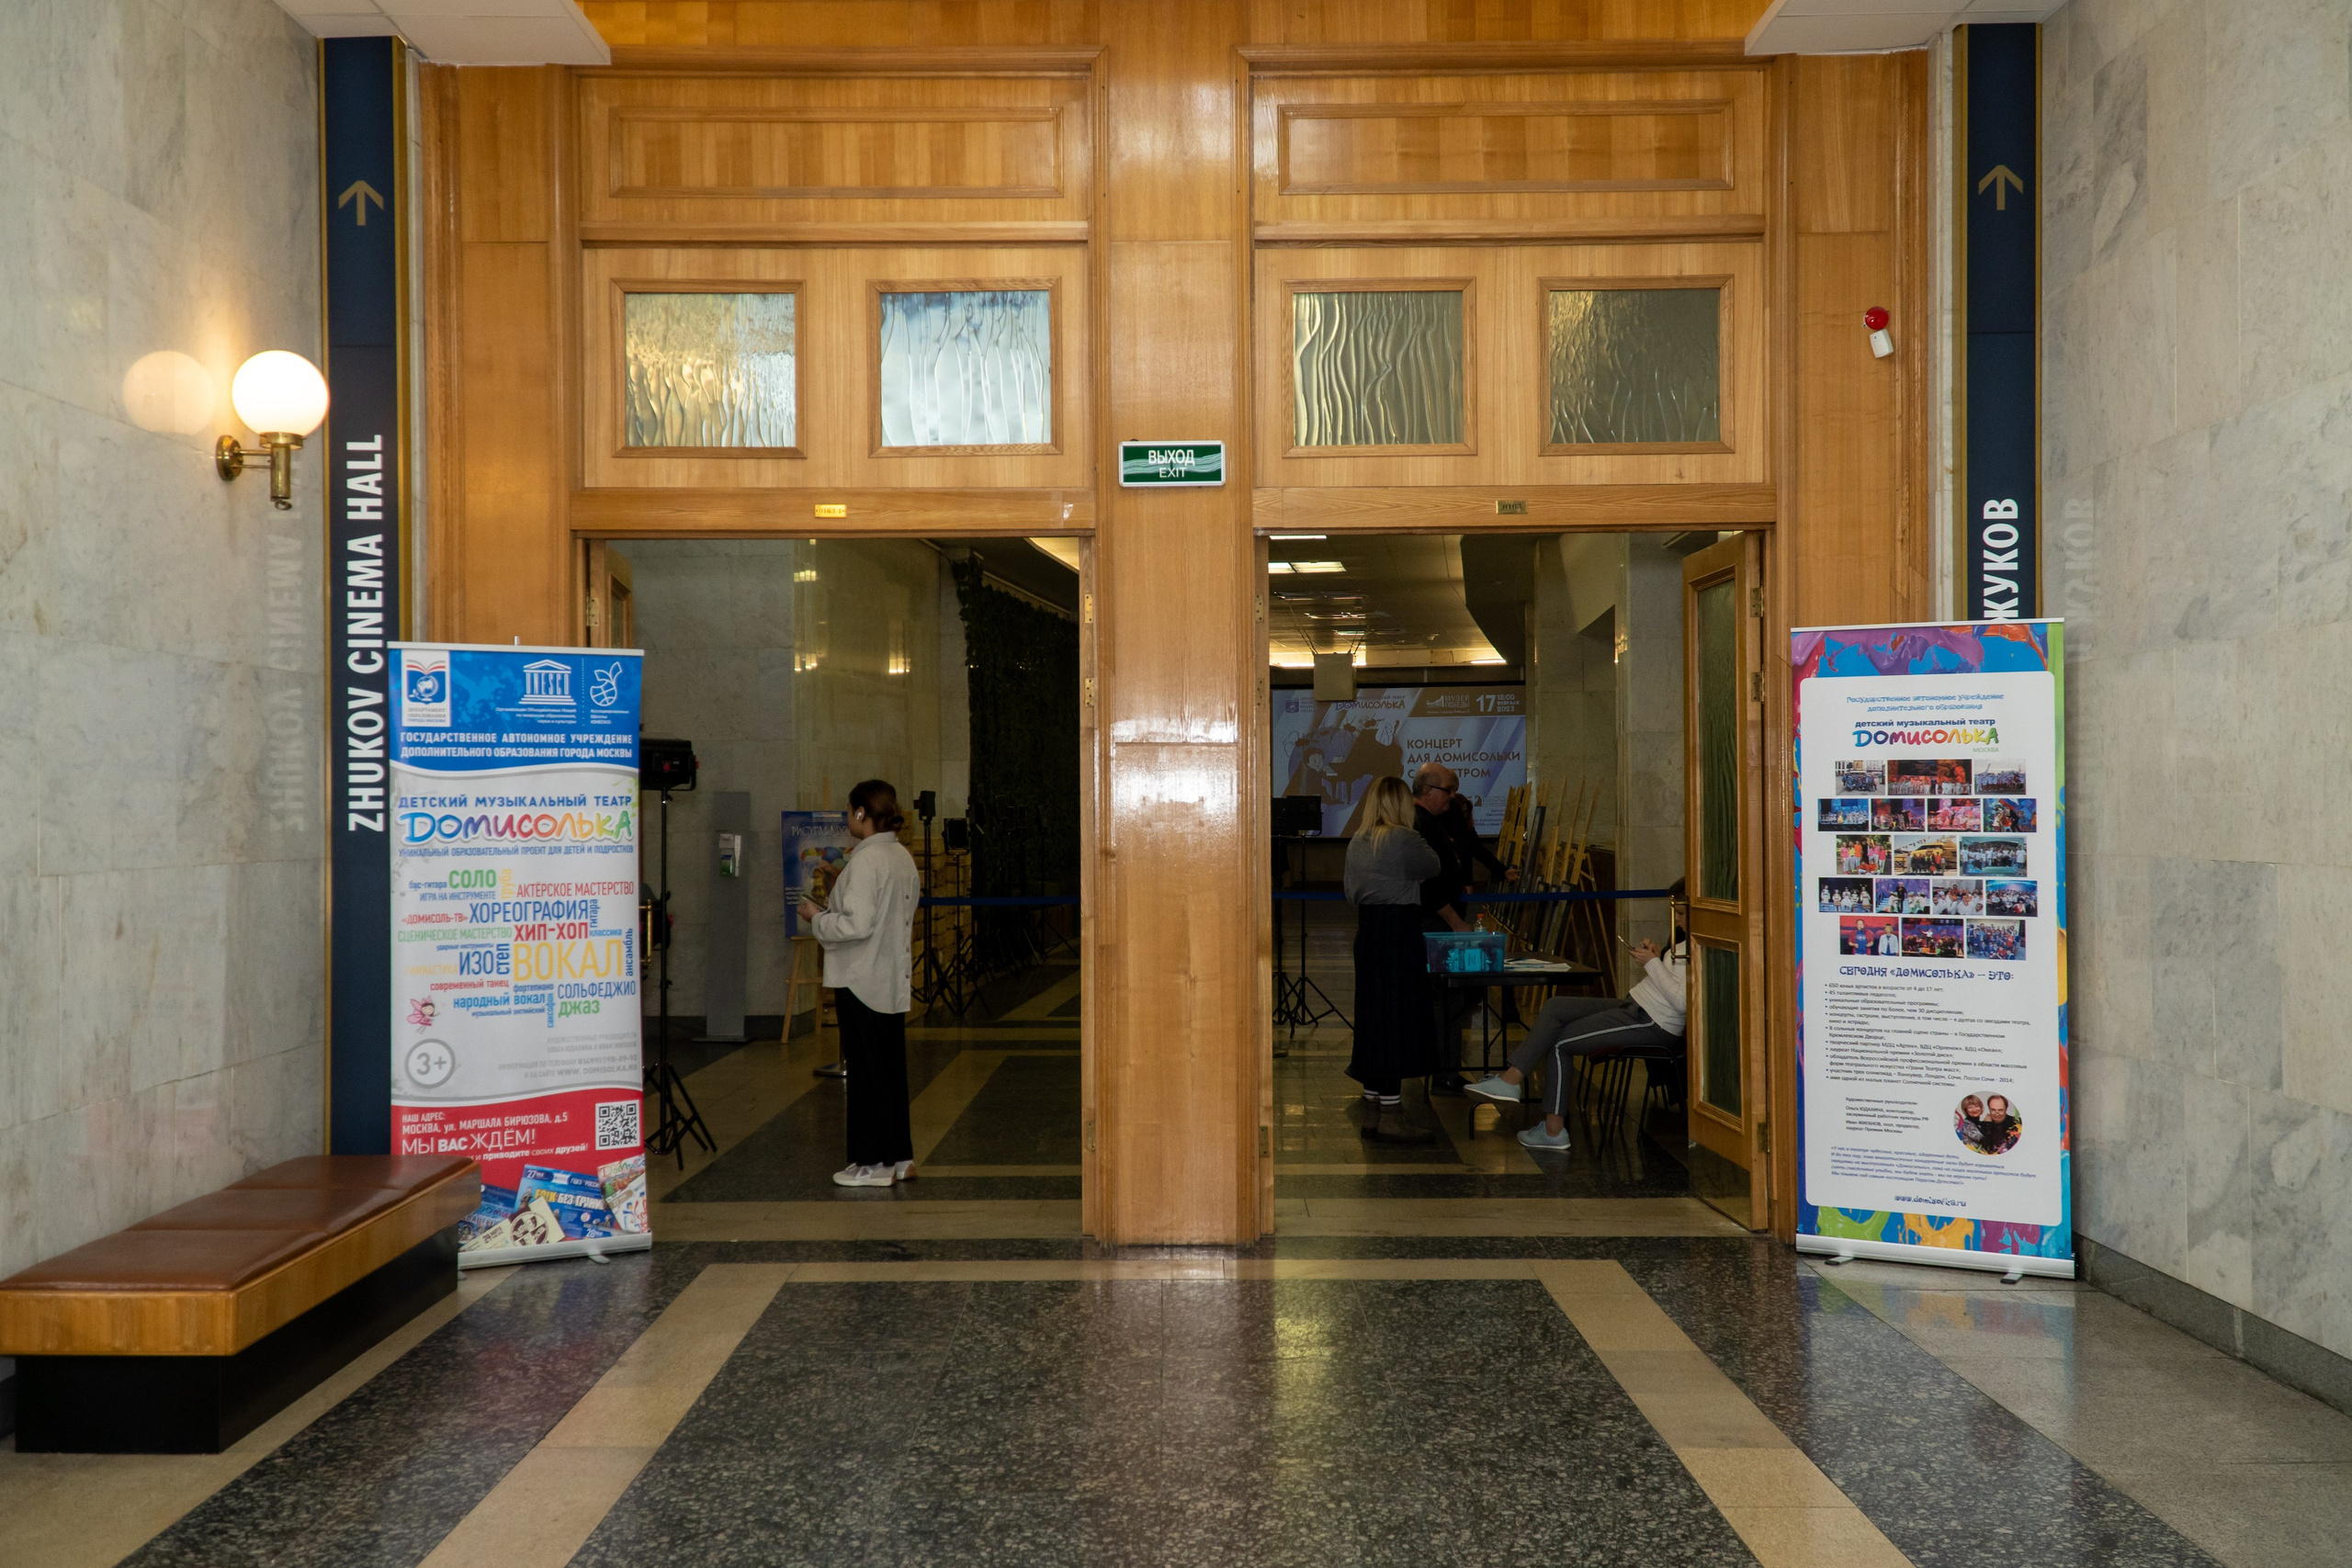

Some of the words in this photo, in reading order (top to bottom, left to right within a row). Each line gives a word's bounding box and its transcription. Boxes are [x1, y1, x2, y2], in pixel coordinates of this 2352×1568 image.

[1148, 449, 1195, 466] ВЫХОД
[346, 434, 383, 520] HALL
[1159, 467, 1187, 478] EXIT
[347, 534, 384, 673] CINEMA
[526, 672, 570, 695] UNESCO
[1476, 694, 1496, 713] 17
[1847, 696, 1911, 705] Государственное
[1913, 694, 1956, 703] автономное
[1958, 694, 2004, 702] учреждение
[1867, 705, 1934, 713] дополнительного
[1855, 719, 1894, 728] детский
[1896, 717, 1966, 728] музыкальный
[1968, 717, 1996, 726] театр
[401, 732, 496, 744] ГОСУДАРСТВЕННОЕ
[502, 733, 566, 744] АВТОНОМНОЕ
[571, 734, 632, 745] УЧРЕЖДЕНИЕ
[1407, 739, 1463, 750] КОНЦЕРТ
[347, 687, 385, 832] ZHUKOV
[401, 746, 492, 758] ДОПОЛНИТЕЛЬНОГО
[493, 747, 559, 758] ОБРАЗОВАНИЯ
[560, 748, 595, 759] ГОРОДА
[596, 749, 632, 758] МОСКВЫ
[1407, 752, 1430, 764] ДЛЯ
[1434, 751, 1521, 763] ДОМИСОЛЬКИ
[1408, 769, 1415, 779] С
[398, 794, 468, 809] ДЕТСКИЙ
[474, 793, 587, 807] МУЗЫКАЛЬНЫЙ
[594, 795, 632, 807] ТЕАТР
[398, 846, 449, 857] УНИКАЛЬНЫЙ
[451, 845, 518, 856] ОБРАЗОВАТЕЛЬНЫЙ
[521, 846, 546, 855] ПРОЕКТ
[548, 846, 562, 855] ДЛЯ
[563, 844, 585, 855] ДЕТЕЙ
[587, 845, 592, 853] И
[594, 844, 634, 854] ПОДРОСТКОВ
[408, 880, 447, 890] бас-гитара
[448, 869, 497, 889] СОЛО
[498, 868, 515, 900] труба
[420, 892, 436, 901] ИГРА
[437, 893, 447, 901] НА
[448, 890, 496, 900] ИНСТРУМЕНТЕ
[516, 880, 572, 898] АКТЁРСКОЕ
[574, 881, 634, 897] МАСТЕРСТВО
[469, 899, 588, 923] ХОРЕОГРАФИЯ
[589, 898, 600, 928] гитара
[397, 929, 458, 942] СЦЕНИЧЕСКОЕ
[459, 927, 512, 941] МАСТЕРСТВО
[514, 922, 588, 942] ХИП-ХОП
[589, 928, 622, 937] классика
[496, 942, 510, 975] степ
[513, 939, 623, 982] ВОКАЛ
[622, 928, 634, 976] ансамбль
[458, 950, 494, 976] ИЗО
[1839, 965, 1887, 977] СЕГОДНЯ
[1890, 967, 1974, 979] «ДОМИСОЛЬКА»
[1988, 970, 2015, 980] ЭТО:
[430, 978, 484, 992] современный
[486, 980, 510, 988] танец
[513, 983, 554, 994] фортепиано
[558, 980, 636, 999] СОЛЬФЕДЖИО
[453, 992, 510, 1011] народный
[514, 993, 546, 1006] вокал
[545, 993, 556, 1029] саксофон
[416, 1052, 447, 1076] 3+
[401, 1114, 419, 1123] НАШ
[421, 1111, 446, 1122] АДРЕС:
[444, 1124, 457, 1134] ул.
[459, 1117, 502, 1131] МАРШАЛА
[401, 1137, 435, 1156] МЫ
[437, 1137, 468, 1153] ВАС
[469, 1128, 536, 1150] ЖДЁМ!
[482, 1149, 530, 1162] приводите
[531, 1147, 554, 1156] своих
